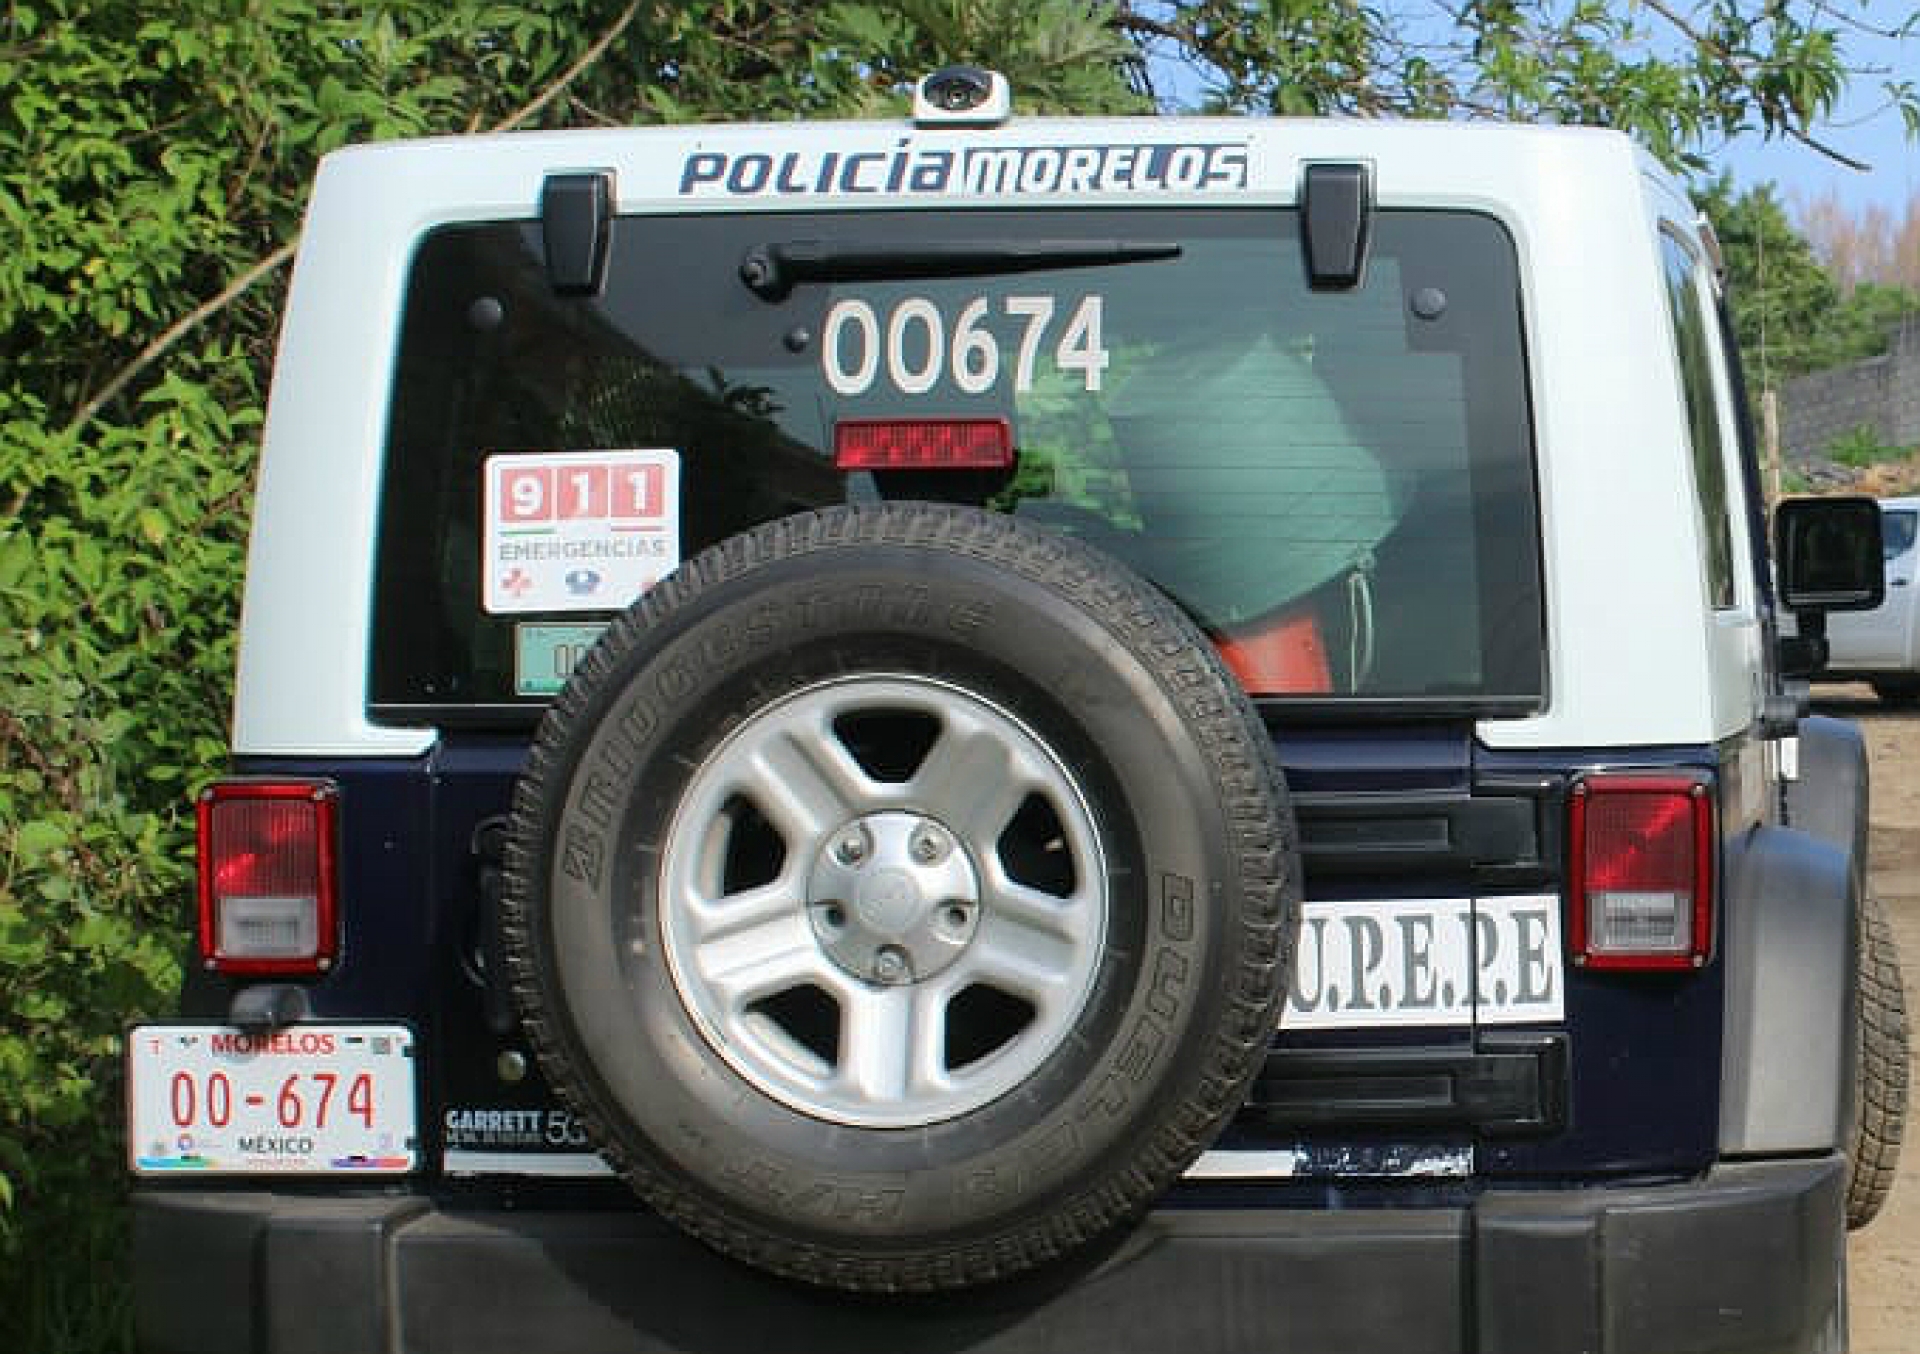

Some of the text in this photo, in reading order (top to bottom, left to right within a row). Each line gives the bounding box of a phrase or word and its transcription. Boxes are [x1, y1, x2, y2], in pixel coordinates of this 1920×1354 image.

[964, 144, 1248, 191] MORELOS
[821, 293, 1110, 395] 00674
[511, 470, 650, 516] 911
[499, 537, 666, 561] EMERGENCIAS
[171, 1070, 377, 1129] 00-674
[446, 1110, 541, 1131] GARRETT
[237, 1134, 315, 1154] MÉXICO
